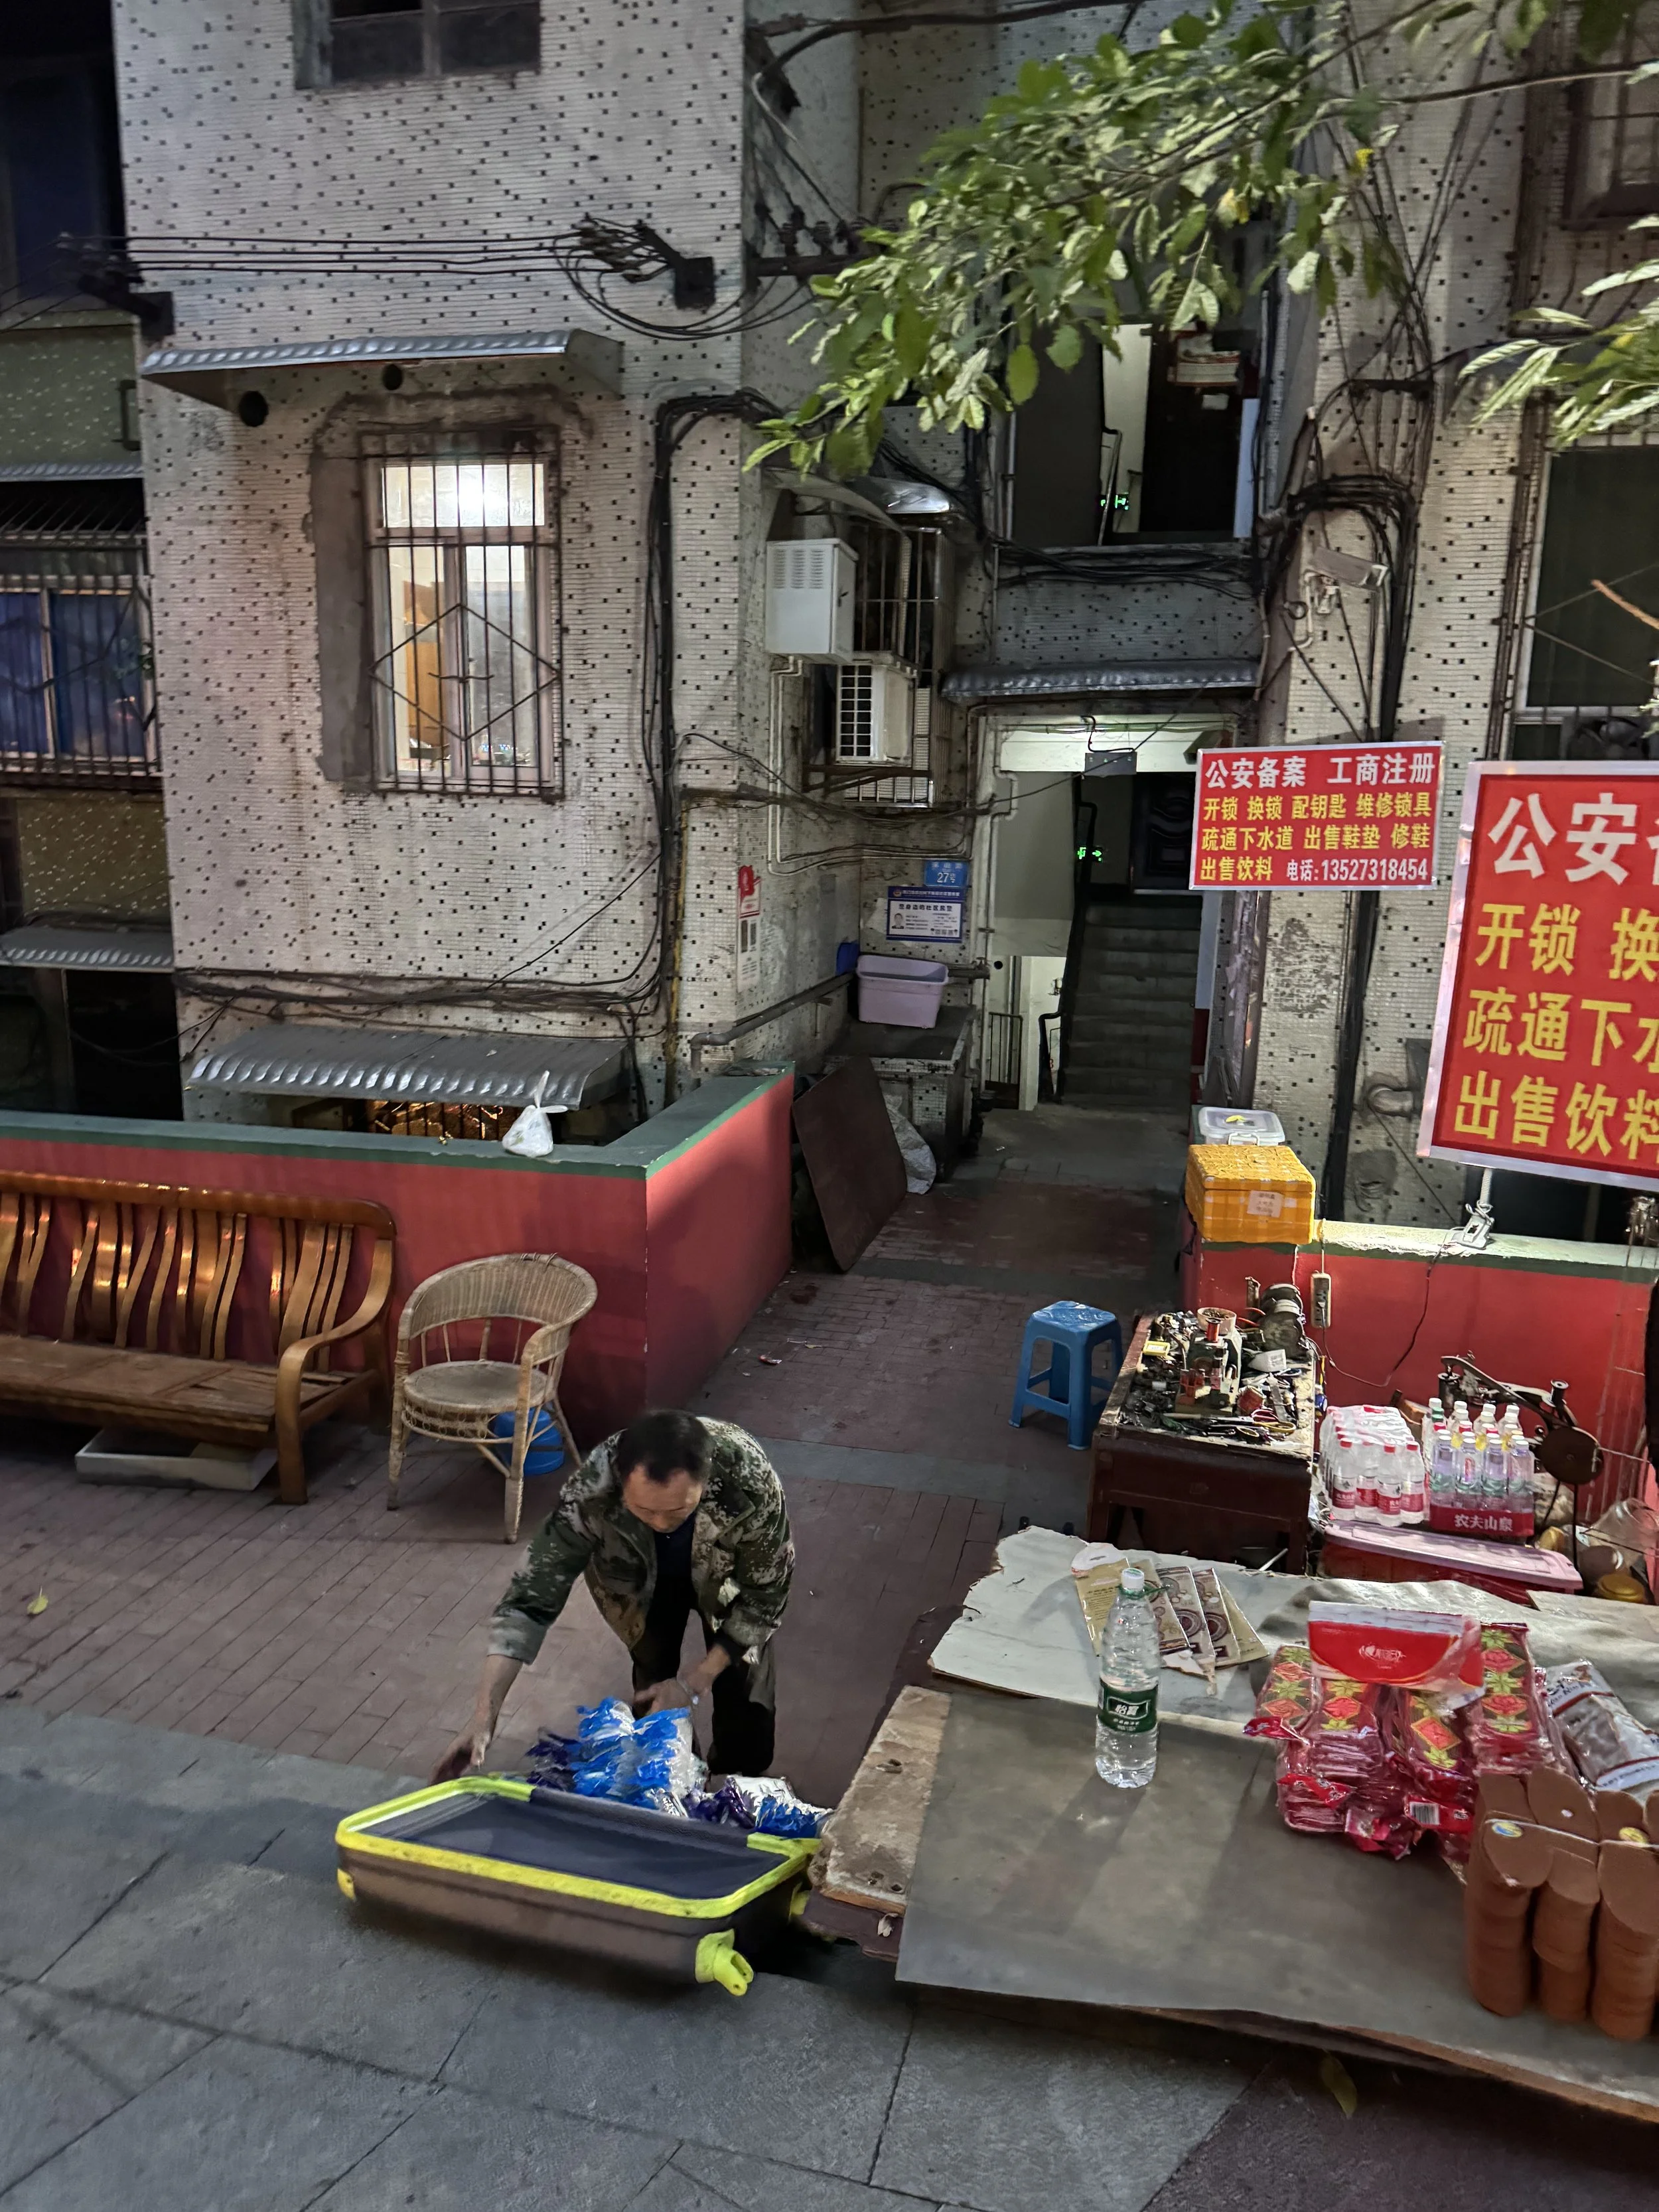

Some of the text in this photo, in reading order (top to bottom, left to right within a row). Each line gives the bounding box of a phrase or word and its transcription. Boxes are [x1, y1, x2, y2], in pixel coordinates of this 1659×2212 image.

[1205, 752, 1435, 789] 公安备案 工商注册
[1203, 792, 1432, 821] 开锁 换锁 配钥匙 维修锁具
[1201, 822, 1431, 851] 疏通下水道 出售鞋垫 修鞋
[1488, 792, 1659, 885] 公安
[937, 872, 956, 883] 27号
[1200, 856, 1273, 881] 出售饮料
[1475, 903, 1581, 976] 开锁
[1454, 1070, 1659, 1161] 出售饮料
[1454, 1514, 1513, 1532] 农夫山泉
